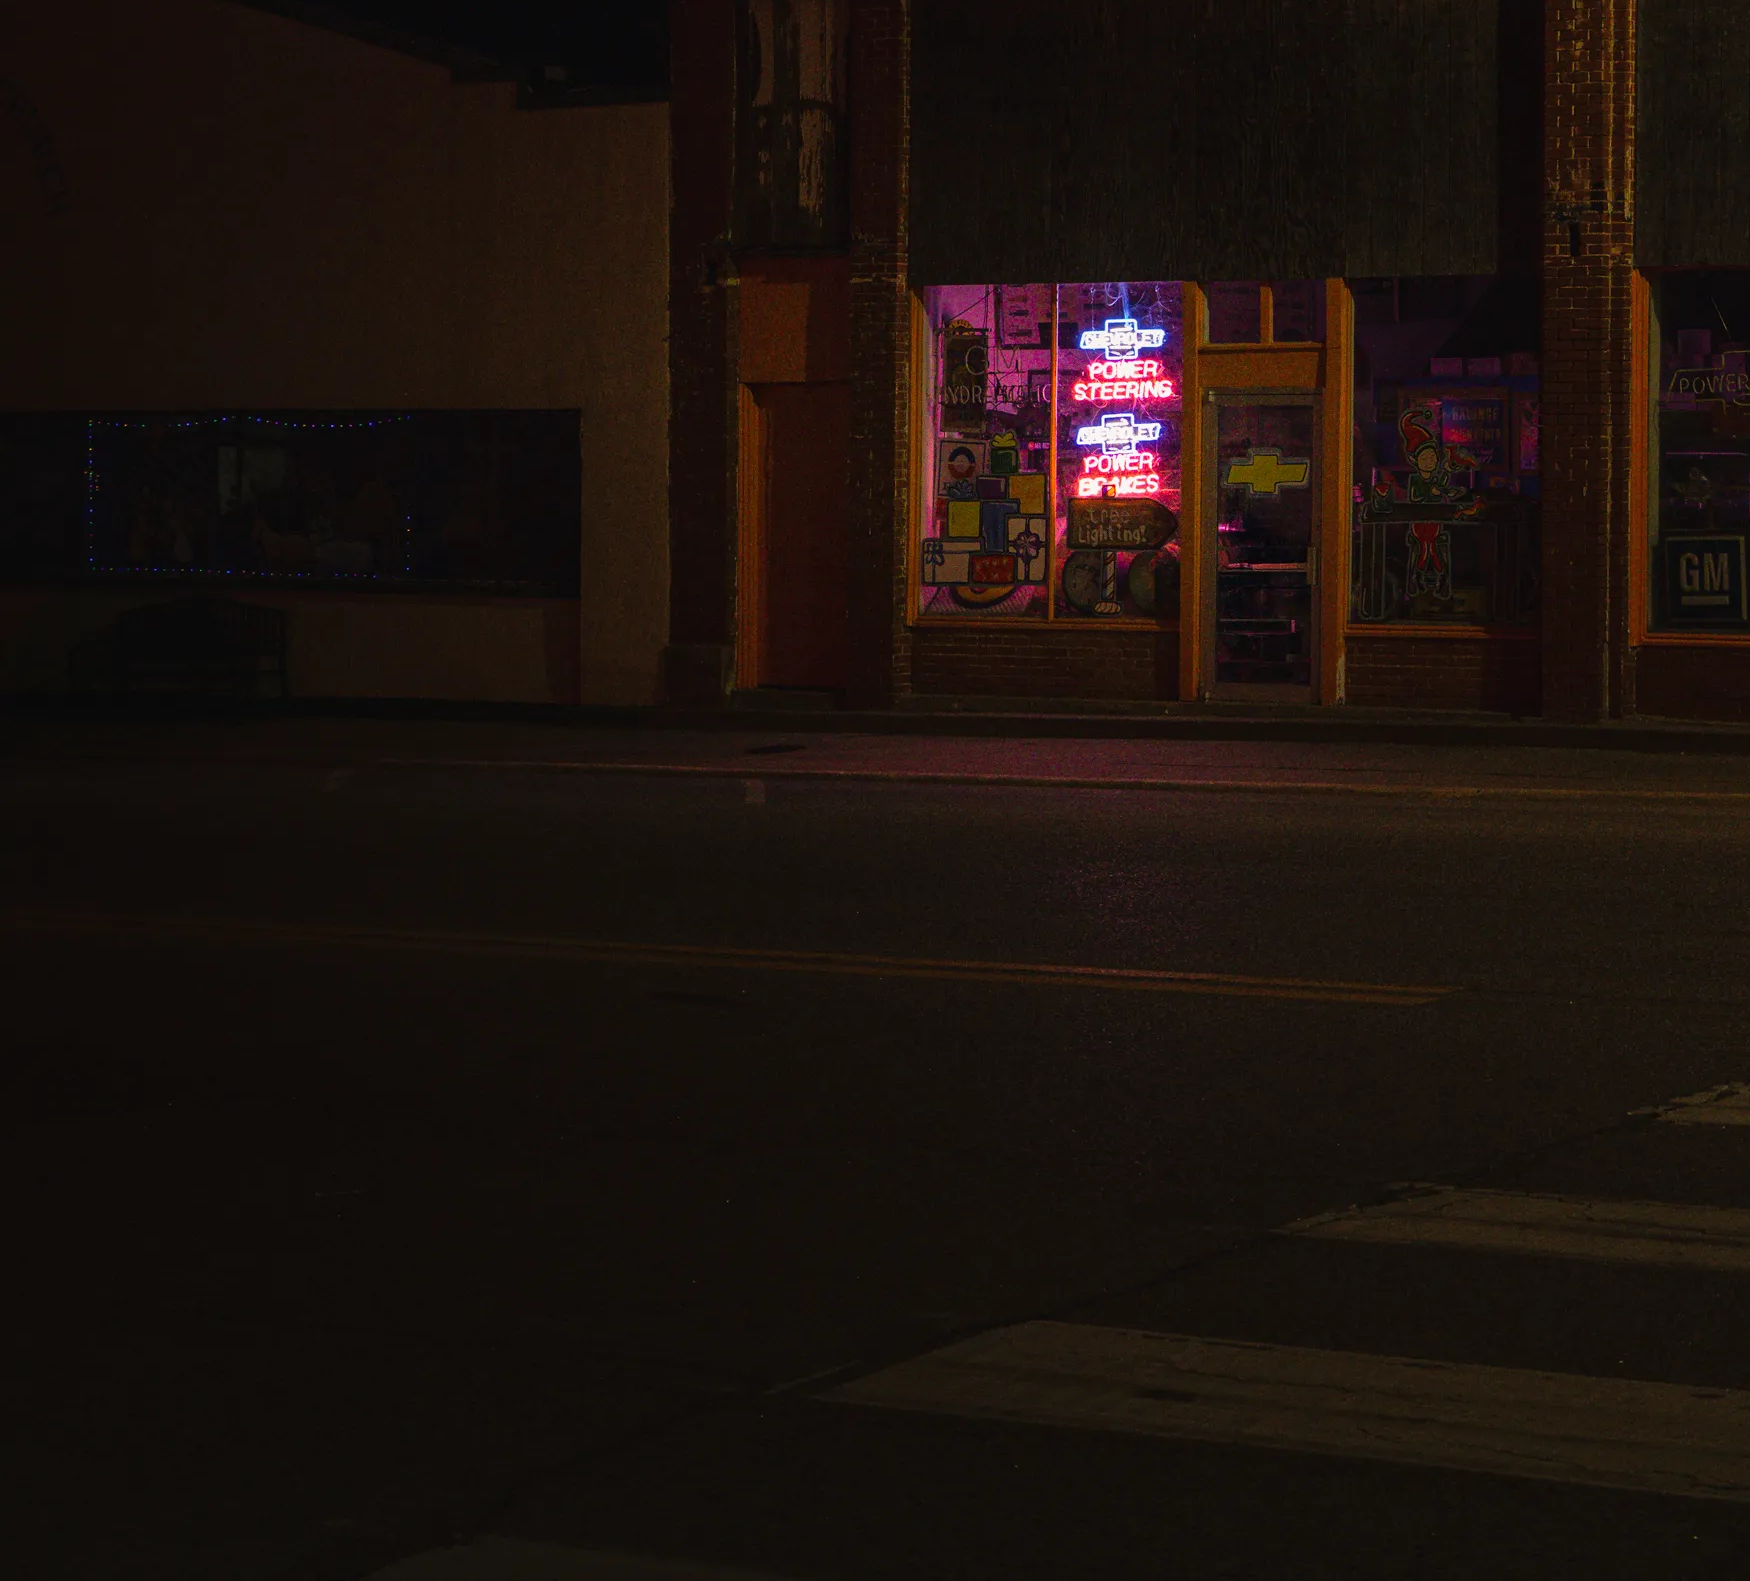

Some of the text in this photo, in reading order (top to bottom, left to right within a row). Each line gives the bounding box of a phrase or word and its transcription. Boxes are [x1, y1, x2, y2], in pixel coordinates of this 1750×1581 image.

[1088, 360, 1159, 380] POWER
[1074, 380, 1173, 401] STEERING
[1679, 373, 1750, 395] POWER
[1084, 452, 1154, 473] POWER
[1078, 473, 1160, 497] BRAKES
[1680, 552, 1730, 593] GM
